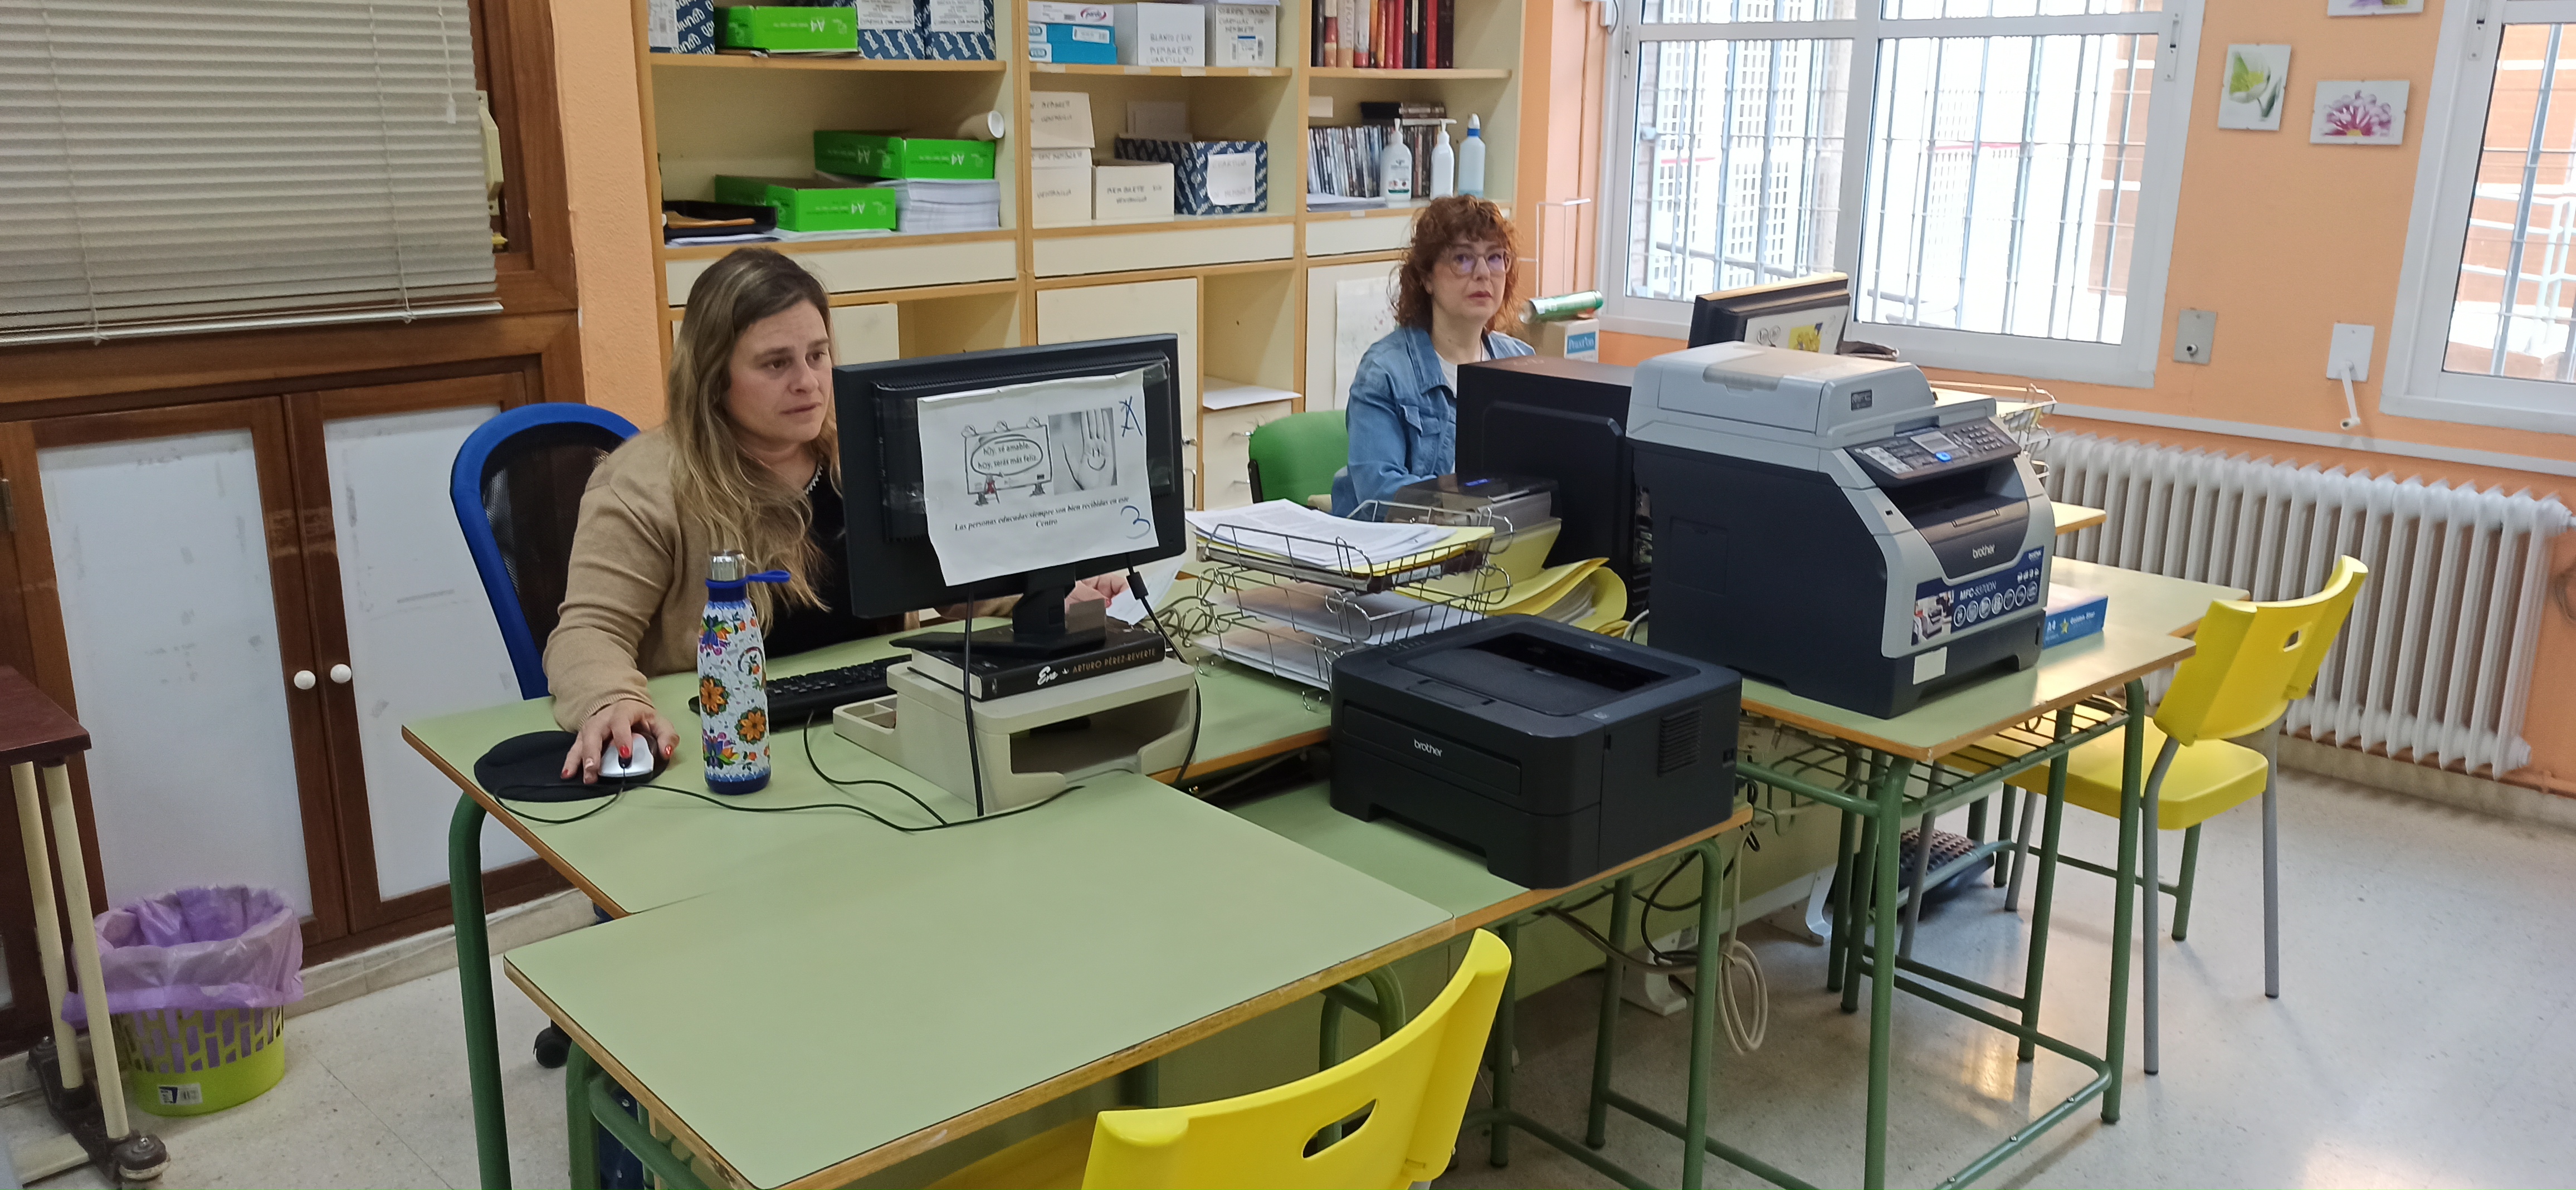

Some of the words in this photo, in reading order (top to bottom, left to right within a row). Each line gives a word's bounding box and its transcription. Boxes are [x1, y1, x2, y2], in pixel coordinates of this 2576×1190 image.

[951, 153, 965, 165] A4
[851, 202, 865, 214] A4
[968, 519, 997, 530] personas
[998, 513, 1028, 524] educadas
[1030, 509, 1054, 519] siempre
[1067, 504, 1080, 512] bien
[1081, 500, 1109, 510] recibidas
[1036, 518, 1058, 528] Centro
[1120, 505, 1151, 539] 3
[1972, 544, 1996, 559] brother
[1037, 666, 1058, 686] Eva
[1072, 660, 1102, 674] ARTURO
[1104, 647, 1156, 666] PÉREZ-REVERTE
[1414, 738, 1443, 757] brother
